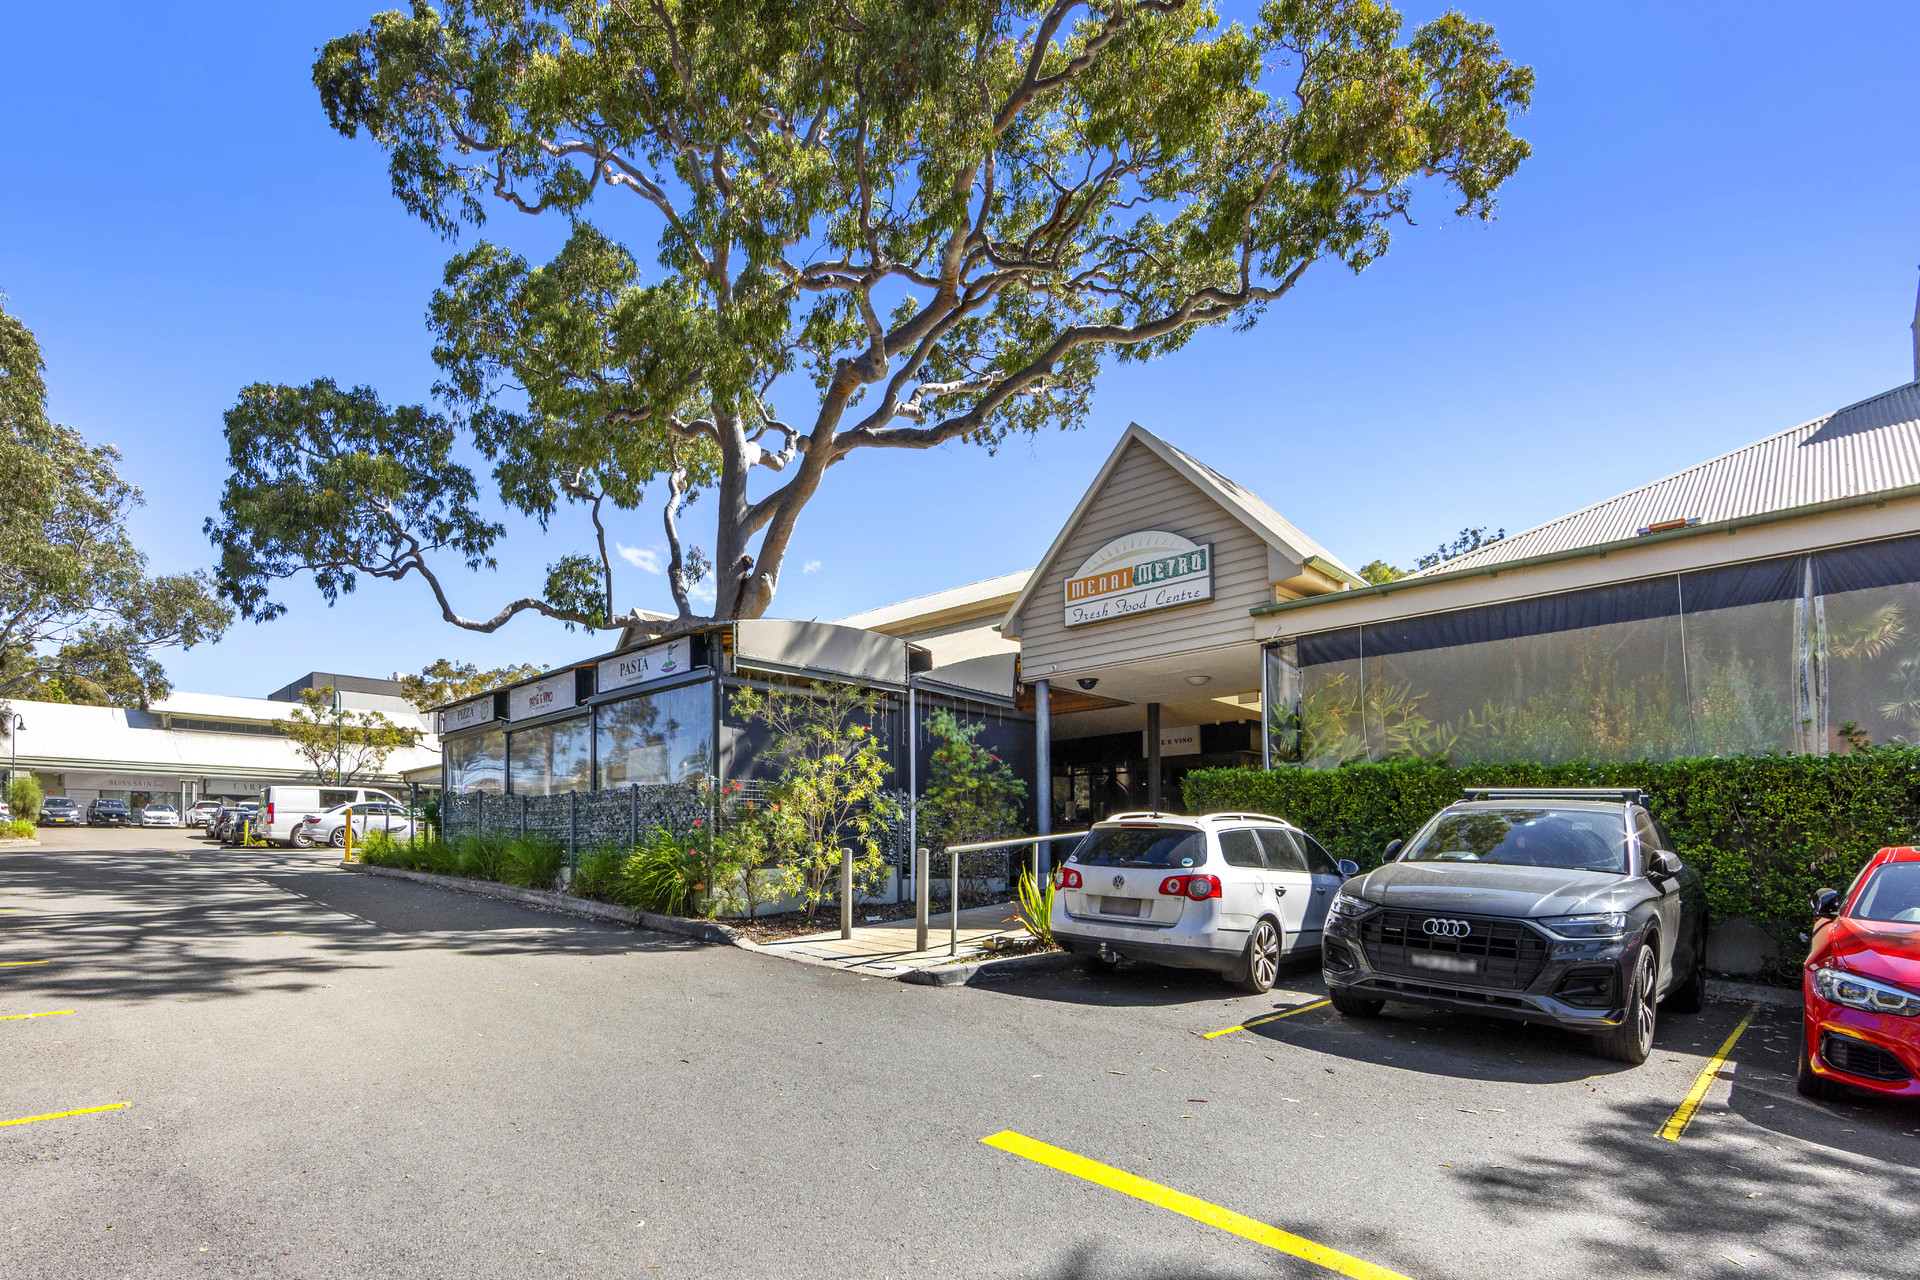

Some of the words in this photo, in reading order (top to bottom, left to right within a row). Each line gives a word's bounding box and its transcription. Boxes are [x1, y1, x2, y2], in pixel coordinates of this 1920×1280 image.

[1072, 571, 1127, 598] MENAI
[1138, 554, 1201, 583] METRO
[1073, 603, 1108, 623] Fresh
[1116, 594, 1147, 614] Food
[1155, 589, 1200, 605] Centre
[620, 657, 649, 676] PASTA
[457, 706, 474, 721] PIZZA
